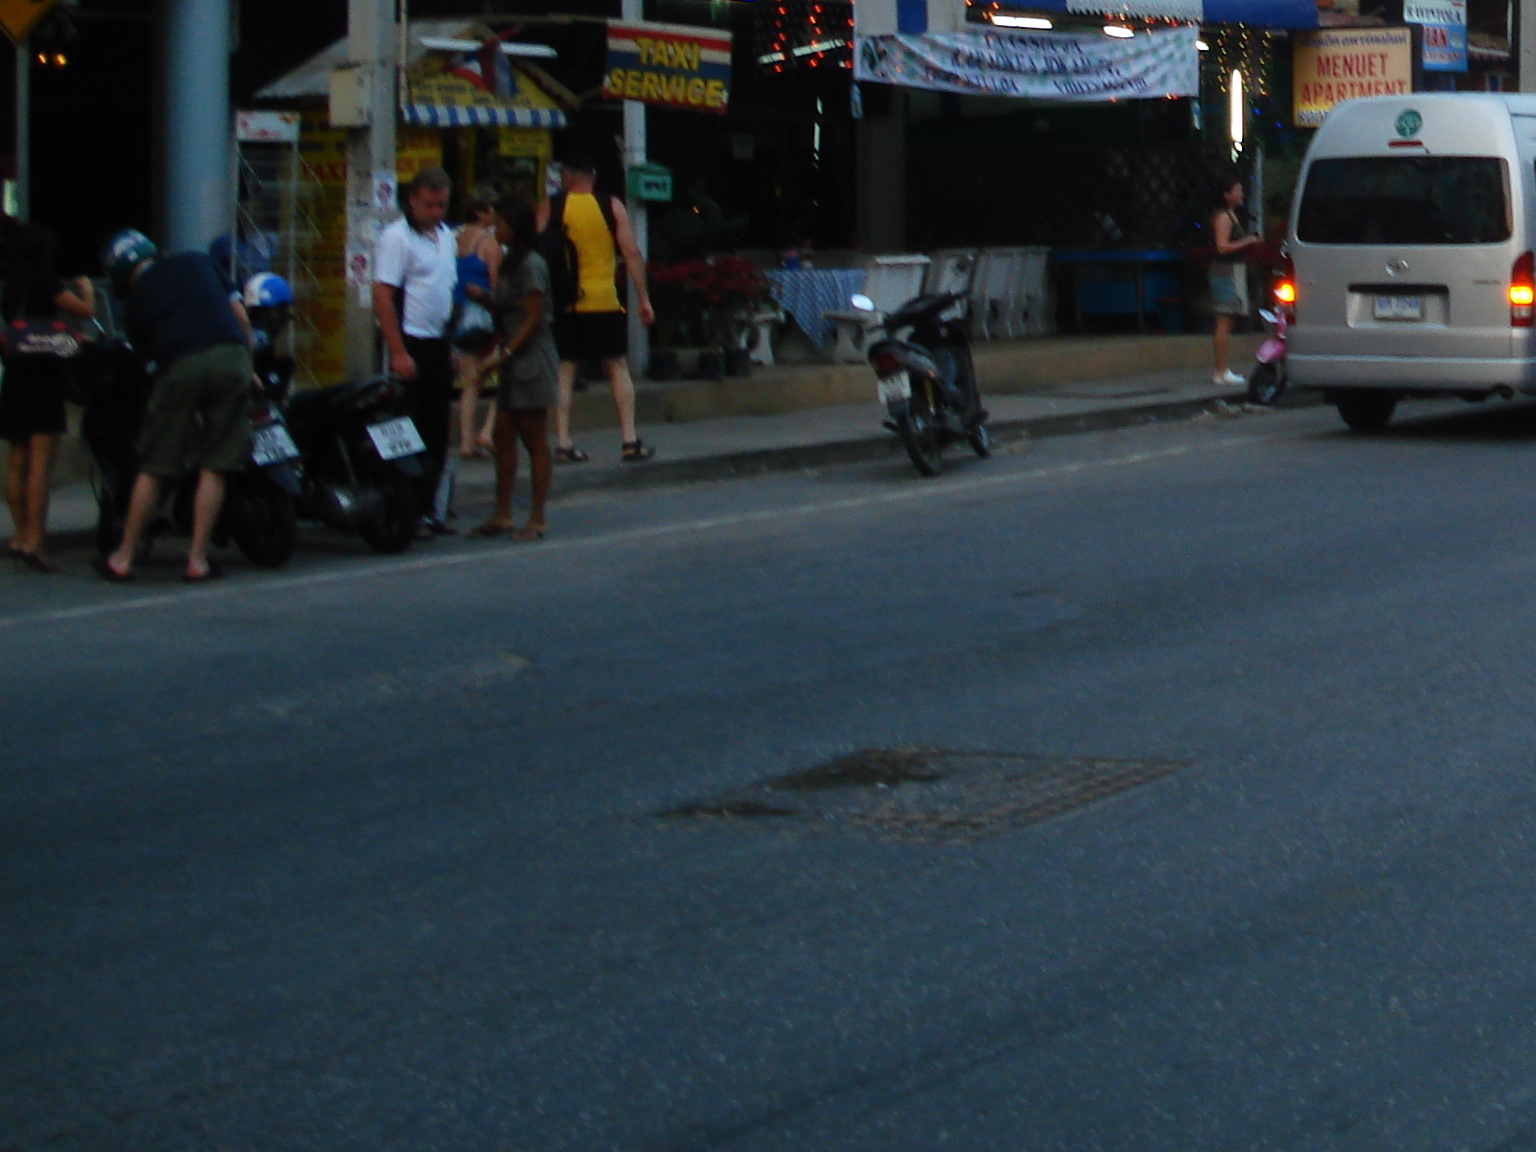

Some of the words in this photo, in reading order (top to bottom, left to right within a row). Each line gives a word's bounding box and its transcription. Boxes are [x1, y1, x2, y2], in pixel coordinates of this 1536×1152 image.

[635, 37, 700, 72] TAXI
[1316, 53, 1389, 78] MENUET
[608, 68, 726, 109] SERVICE
[1301, 79, 1407, 106] APARTMENT
